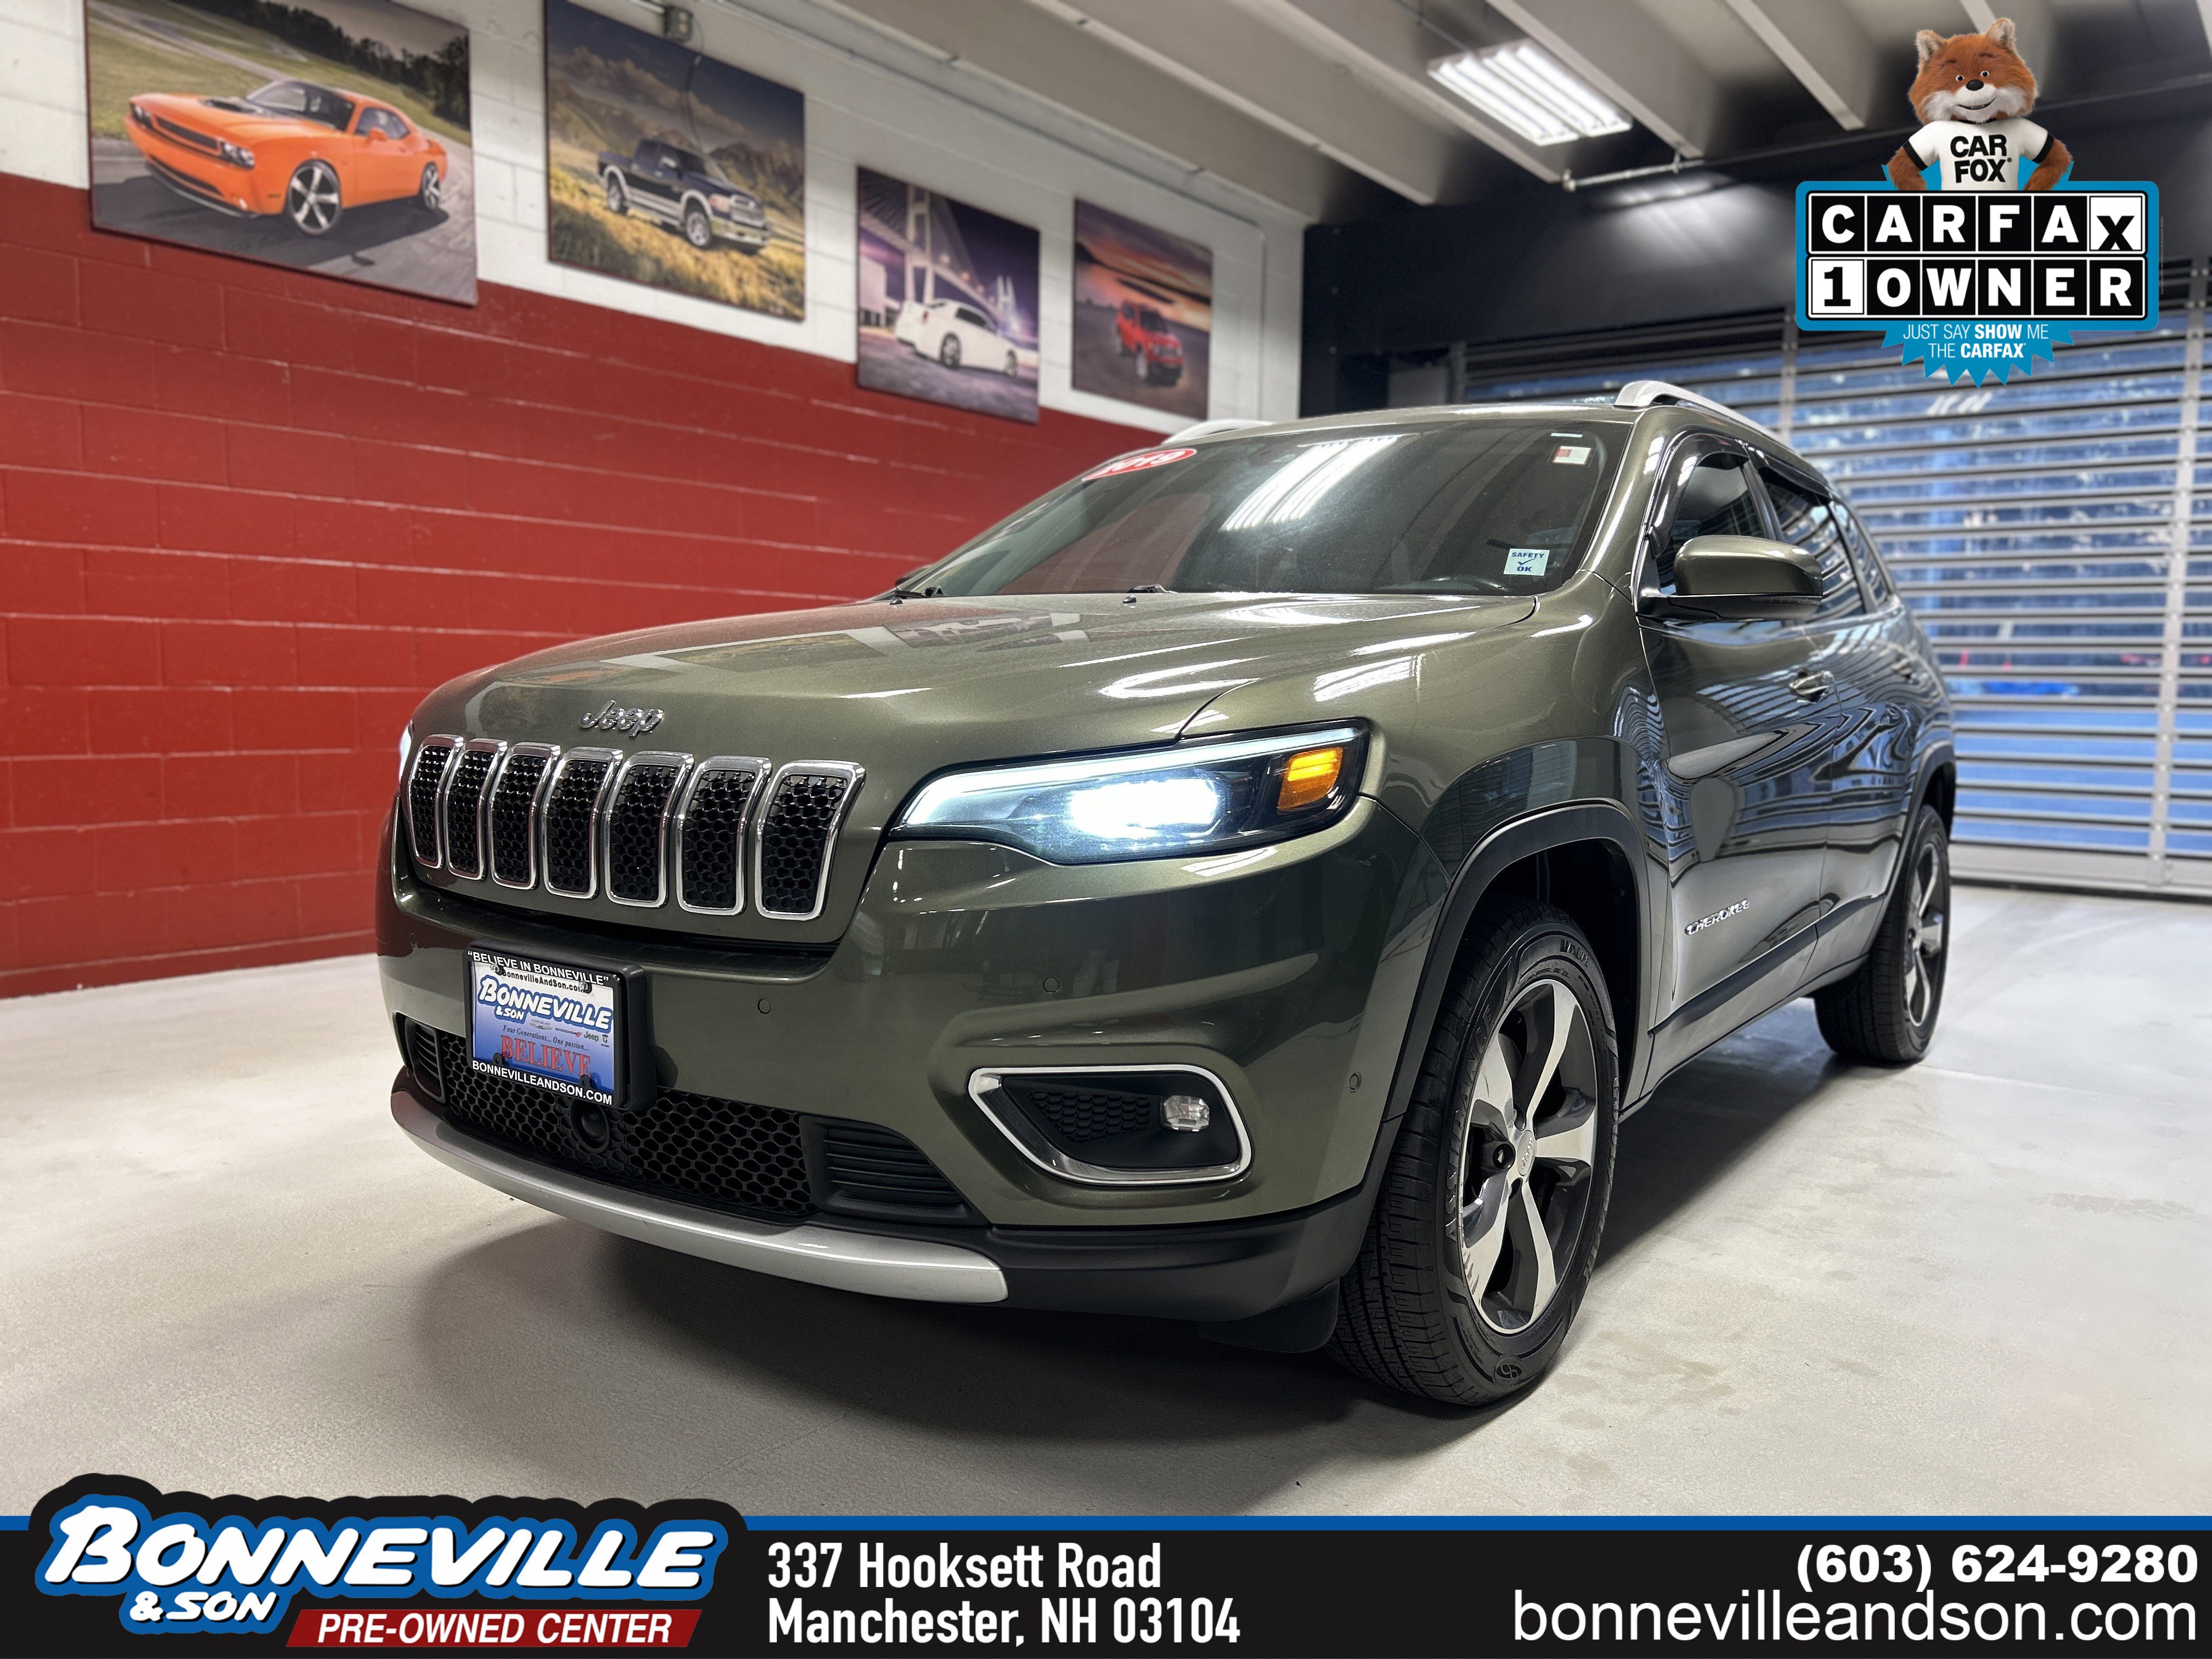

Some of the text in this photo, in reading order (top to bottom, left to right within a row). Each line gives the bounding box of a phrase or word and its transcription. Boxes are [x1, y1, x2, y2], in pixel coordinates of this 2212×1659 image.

[578, 699, 665, 737] Jeep
[520, 961, 531, 972] IN
[479, 977, 613, 1030] BONNEVILLE
[503, 1025, 515, 1034] Four
[553, 1037, 564, 1045] One
[584, 1031, 599, 1042] Jeep
[472, 1060, 612, 1105] BONNEVILLEANDSON.COM
